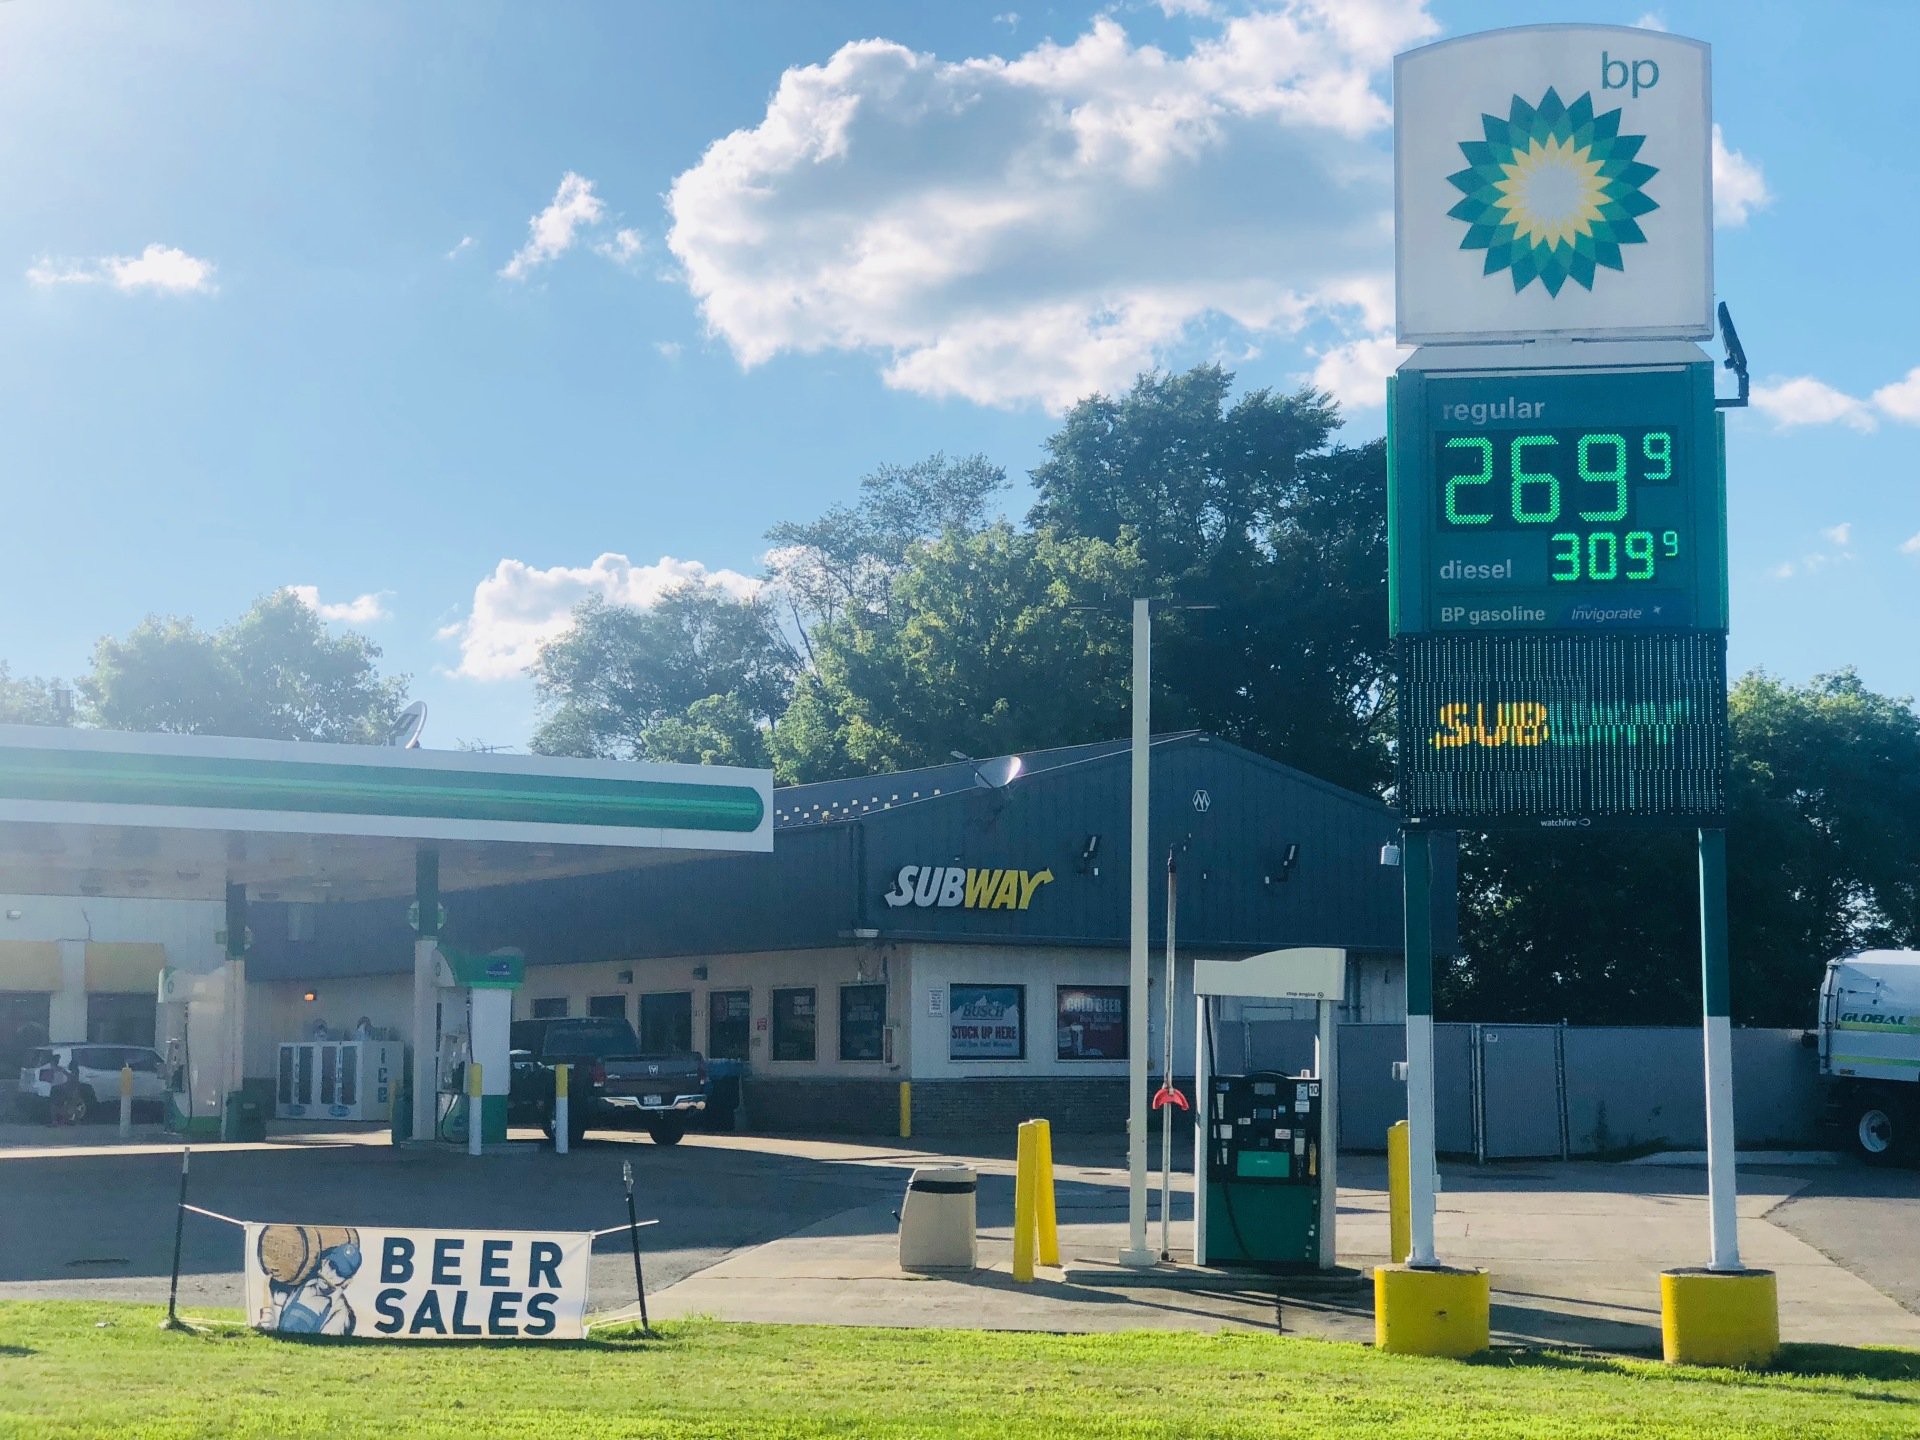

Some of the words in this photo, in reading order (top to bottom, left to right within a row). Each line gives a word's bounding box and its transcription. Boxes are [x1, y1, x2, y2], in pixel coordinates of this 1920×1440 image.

[1602, 50, 1659, 99] bp
[1443, 397, 1546, 425] regular
[1440, 559, 1512, 580] diesel
[1441, 607, 1465, 622] BP
[1469, 606, 1546, 625] gasoline
[1571, 607, 1642, 623] Invigorate
[1540, 818, 1577, 827] watchfire
[884, 865, 1055, 910] SUBWAY
[1841, 1012, 1906, 1025] GLOBAL
[380, 1237, 564, 1289] BEER
[374, 1288, 559, 1336] SALES
